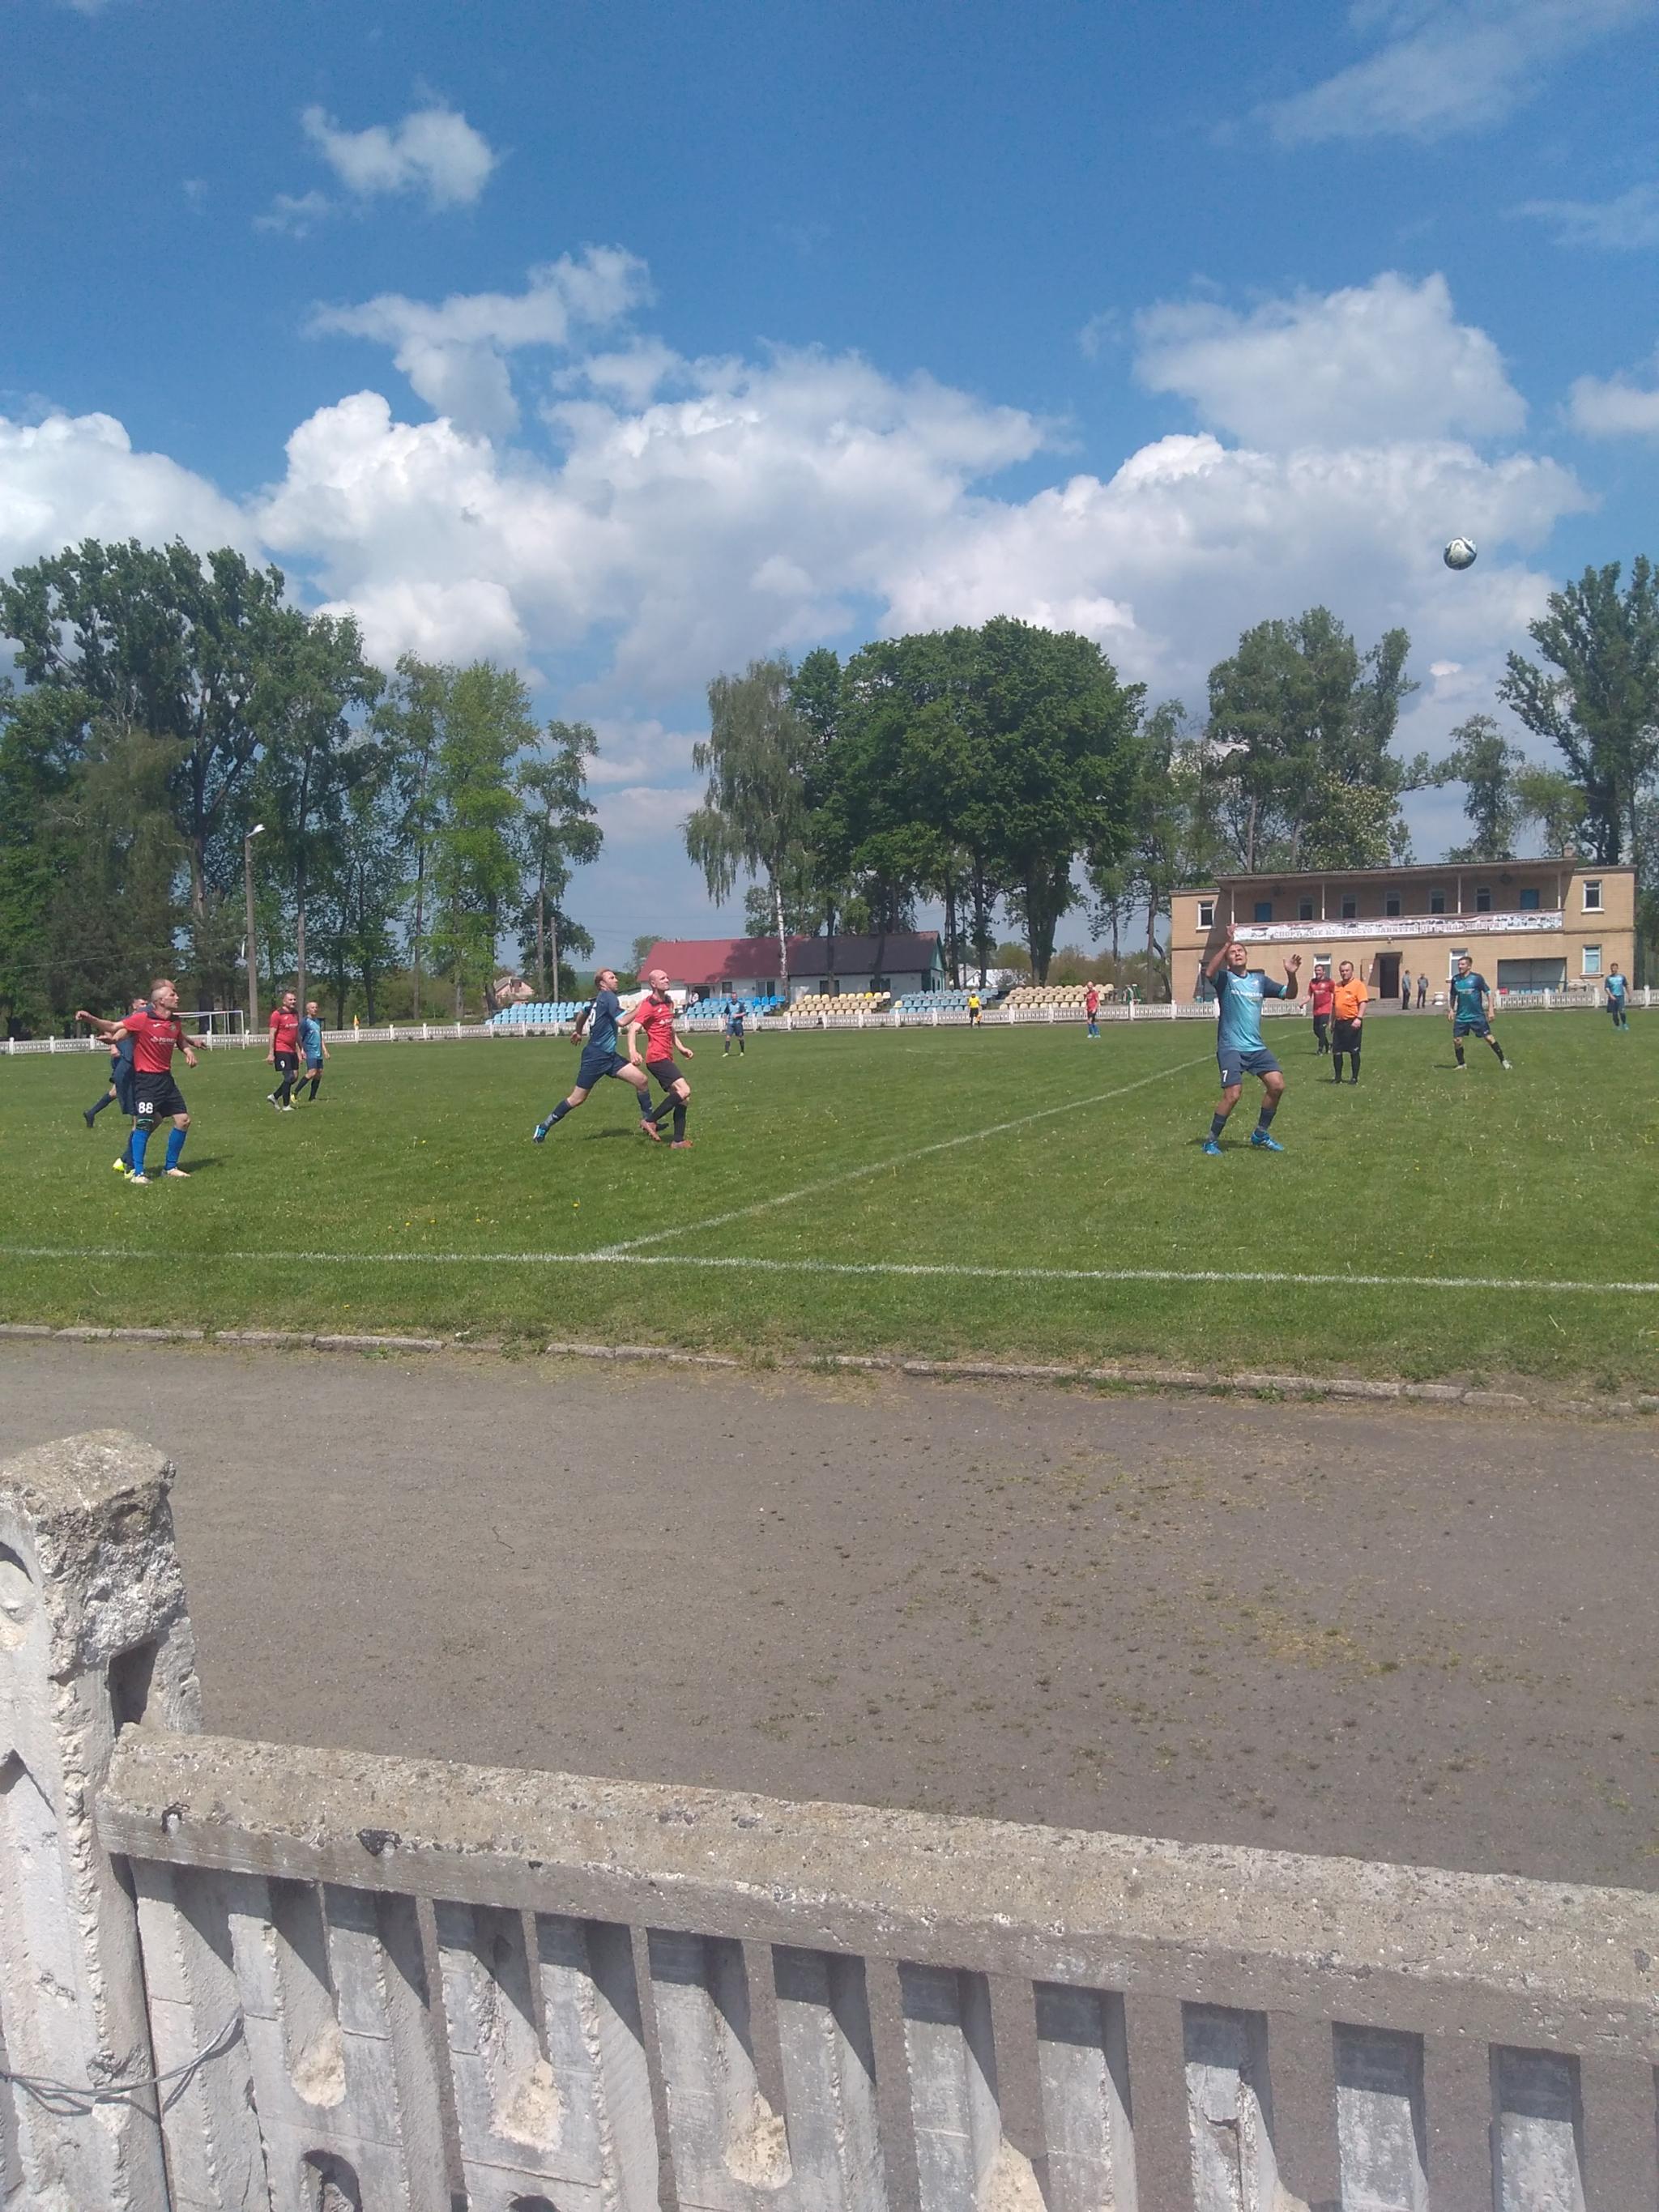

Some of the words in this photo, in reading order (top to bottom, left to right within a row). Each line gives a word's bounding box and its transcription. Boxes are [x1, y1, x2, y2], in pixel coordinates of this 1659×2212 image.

[1340, 927, 1373, 936] ПРОСТО
[279, 1059, 285, 1068] 9
[1222, 1069, 1228, 1083] 7
[138, 1101, 154, 1115] 88
